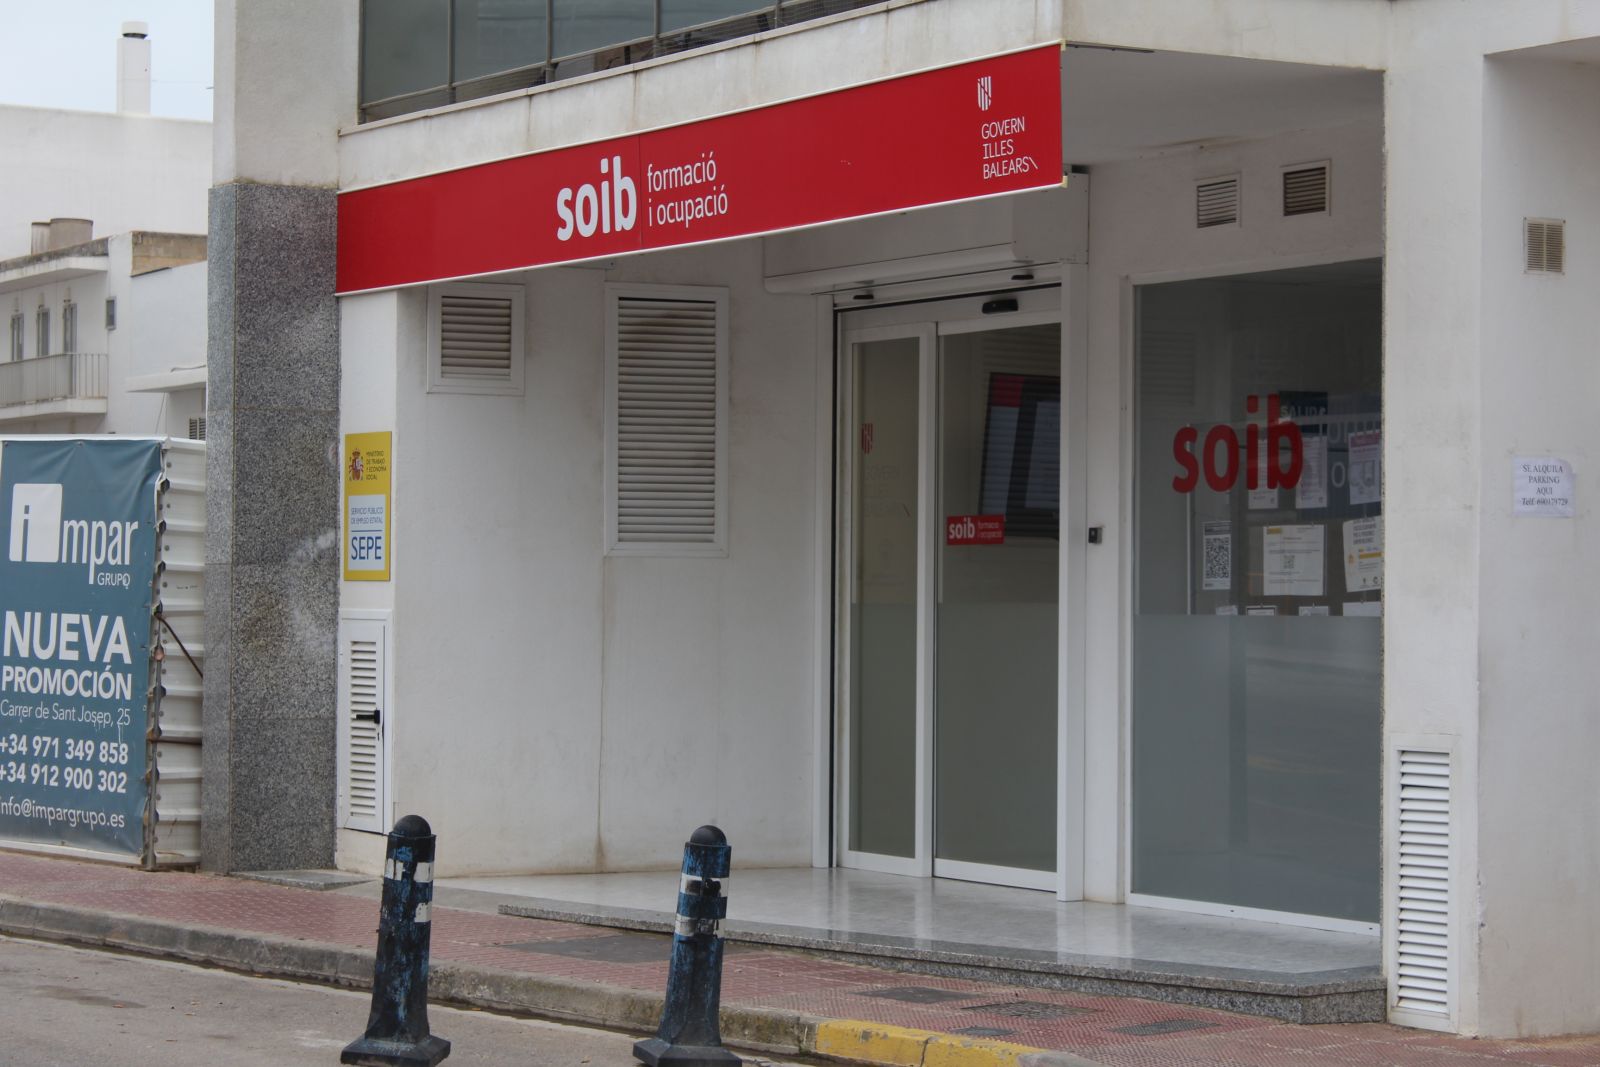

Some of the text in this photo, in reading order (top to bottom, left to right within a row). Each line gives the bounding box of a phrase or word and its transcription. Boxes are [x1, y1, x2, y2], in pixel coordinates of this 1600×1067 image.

[981, 116, 1025, 139] GOVERN
[982, 139, 1014, 159] ILLES
[647, 151, 717, 193] formació
[556, 155, 637, 241] soib
[648, 184, 728, 228] i ocupació
[1172, 393, 1304, 493] soib
[1528, 475, 1560, 484] PARKING
[1533, 464, 1563, 474] ALQUILA
[21, 502, 139, 585] impar
[949, 517, 975, 539] soib
[351, 536, 382, 560] SEPE
[97, 572, 131, 587] GRUPO
[3, 610, 132, 664] NUEVA
[1, 665, 132, 700] PROMOCIÓN
[0, 699, 131, 728] Carrer de Sant Josep, 25
[0, 733, 129, 765] +34 971 349 858
[31, 763, 59, 787] 912
[64, 766, 93, 790] 900
[98, 770, 127, 794] 302
